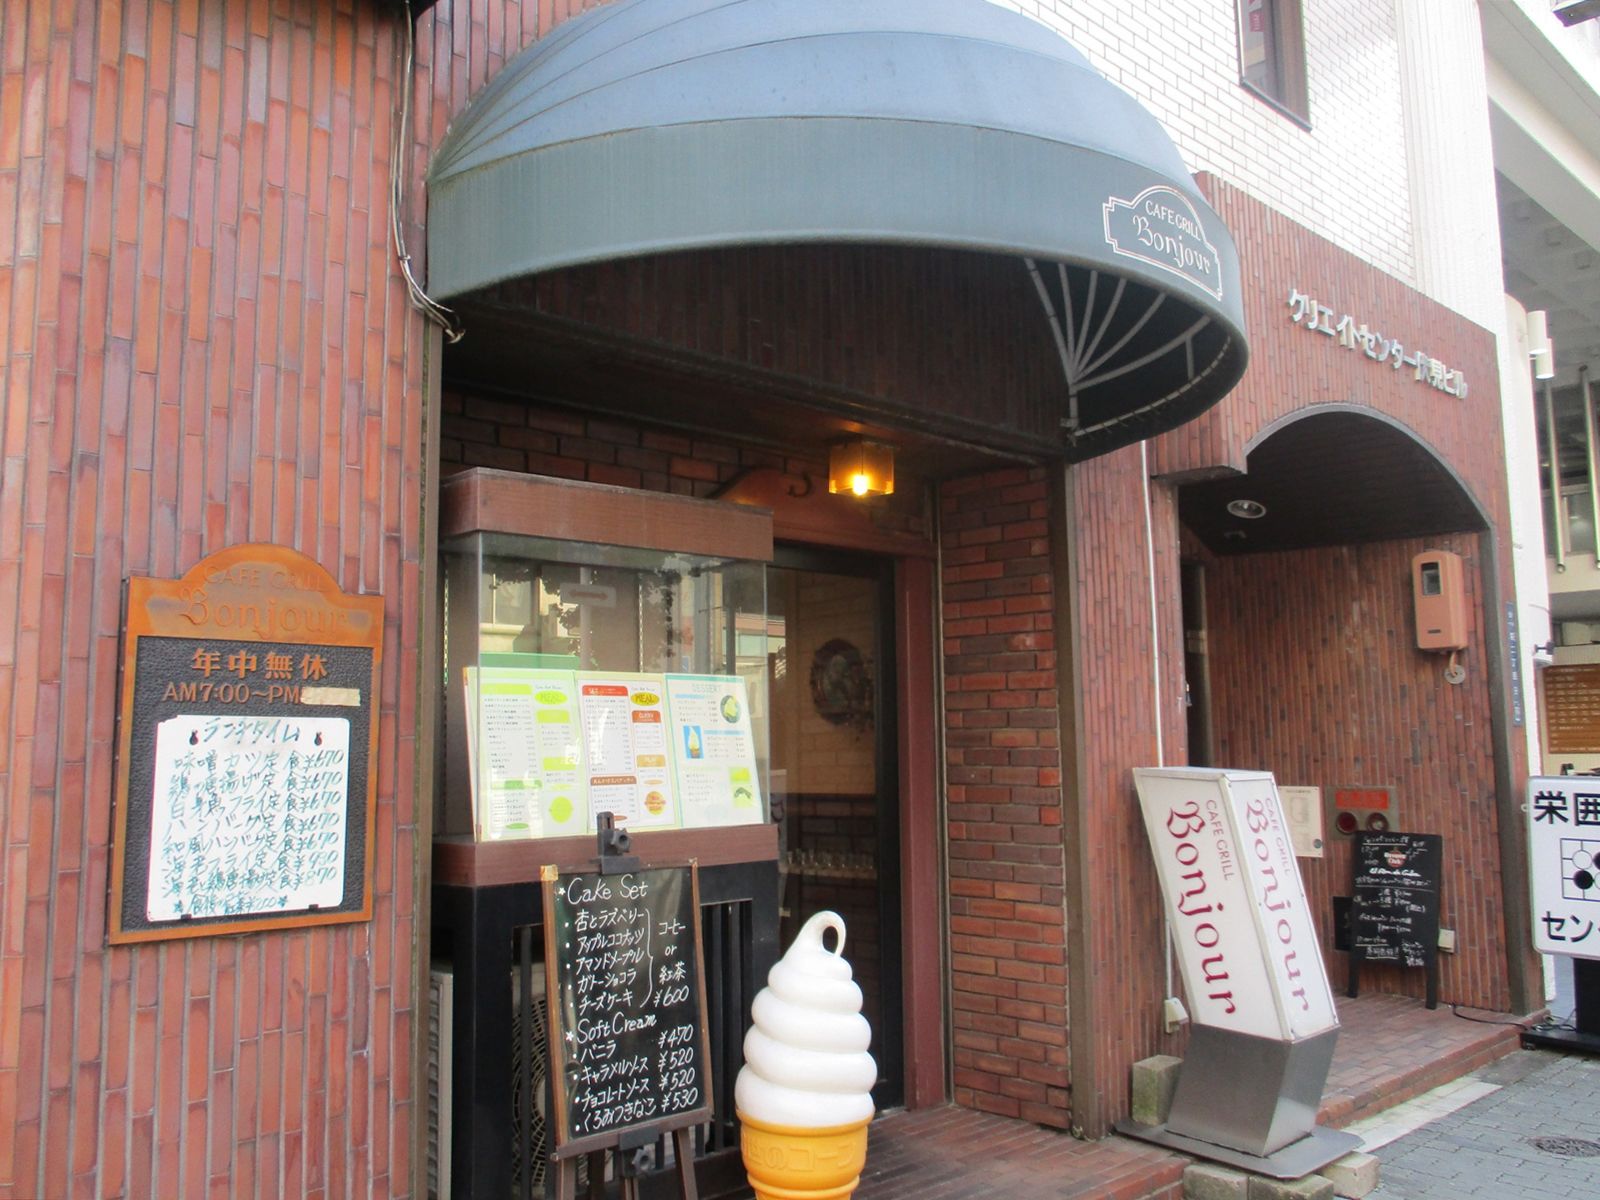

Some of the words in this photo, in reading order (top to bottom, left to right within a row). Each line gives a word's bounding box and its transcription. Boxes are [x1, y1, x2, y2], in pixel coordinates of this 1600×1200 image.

[1145, 200, 1175, 225] CAFE
[1175, 214, 1201, 241] GRILL
[1133, 215, 1211, 274] Bonjour
[204, 565, 259, 587] CAFE
[269, 571, 328, 593] GRILL
[178, 587, 348, 640] Bonjour
[192, 648, 328, 681] 年中無休
[1264, 797, 1281, 839] CAFE
[1205, 799, 1223, 839] CAFE
[1216, 834, 1236, 882] GRILL
[567, 877, 612, 905] Cake
[619, 873, 648, 899] Set
[1247, 799, 1310, 1012] Bonjour
[574, 907, 645, 932] 杏とラズベリー
[1166, 800, 1237, 1015] Bonjour
[577, 927, 645, 956] アップルココナッツ
[1541, 910, 1600, 943] セン
[575, 947, 645, 976] アマンドメープル
[664, 945, 677, 957] or
[658, 960, 687, 986] 紅茶
[578, 989, 633, 1016] チーズケーキ
[655, 984, 689, 1008] ¥600
[576, 1018, 611, 1044] Soft
[612, 1011, 657, 1035] Cream
[580, 1039, 617, 1063] バニラ
[658, 1023, 694, 1049] ¥470
[580, 1055, 649, 1085] キャラメルソース
[657, 1047, 694, 1072] ¥520
[580, 1078, 650, 1112] チョコレートソース
[658, 1067, 696, 1091] ¥520
[661, 1087, 699, 1113] ¥530
